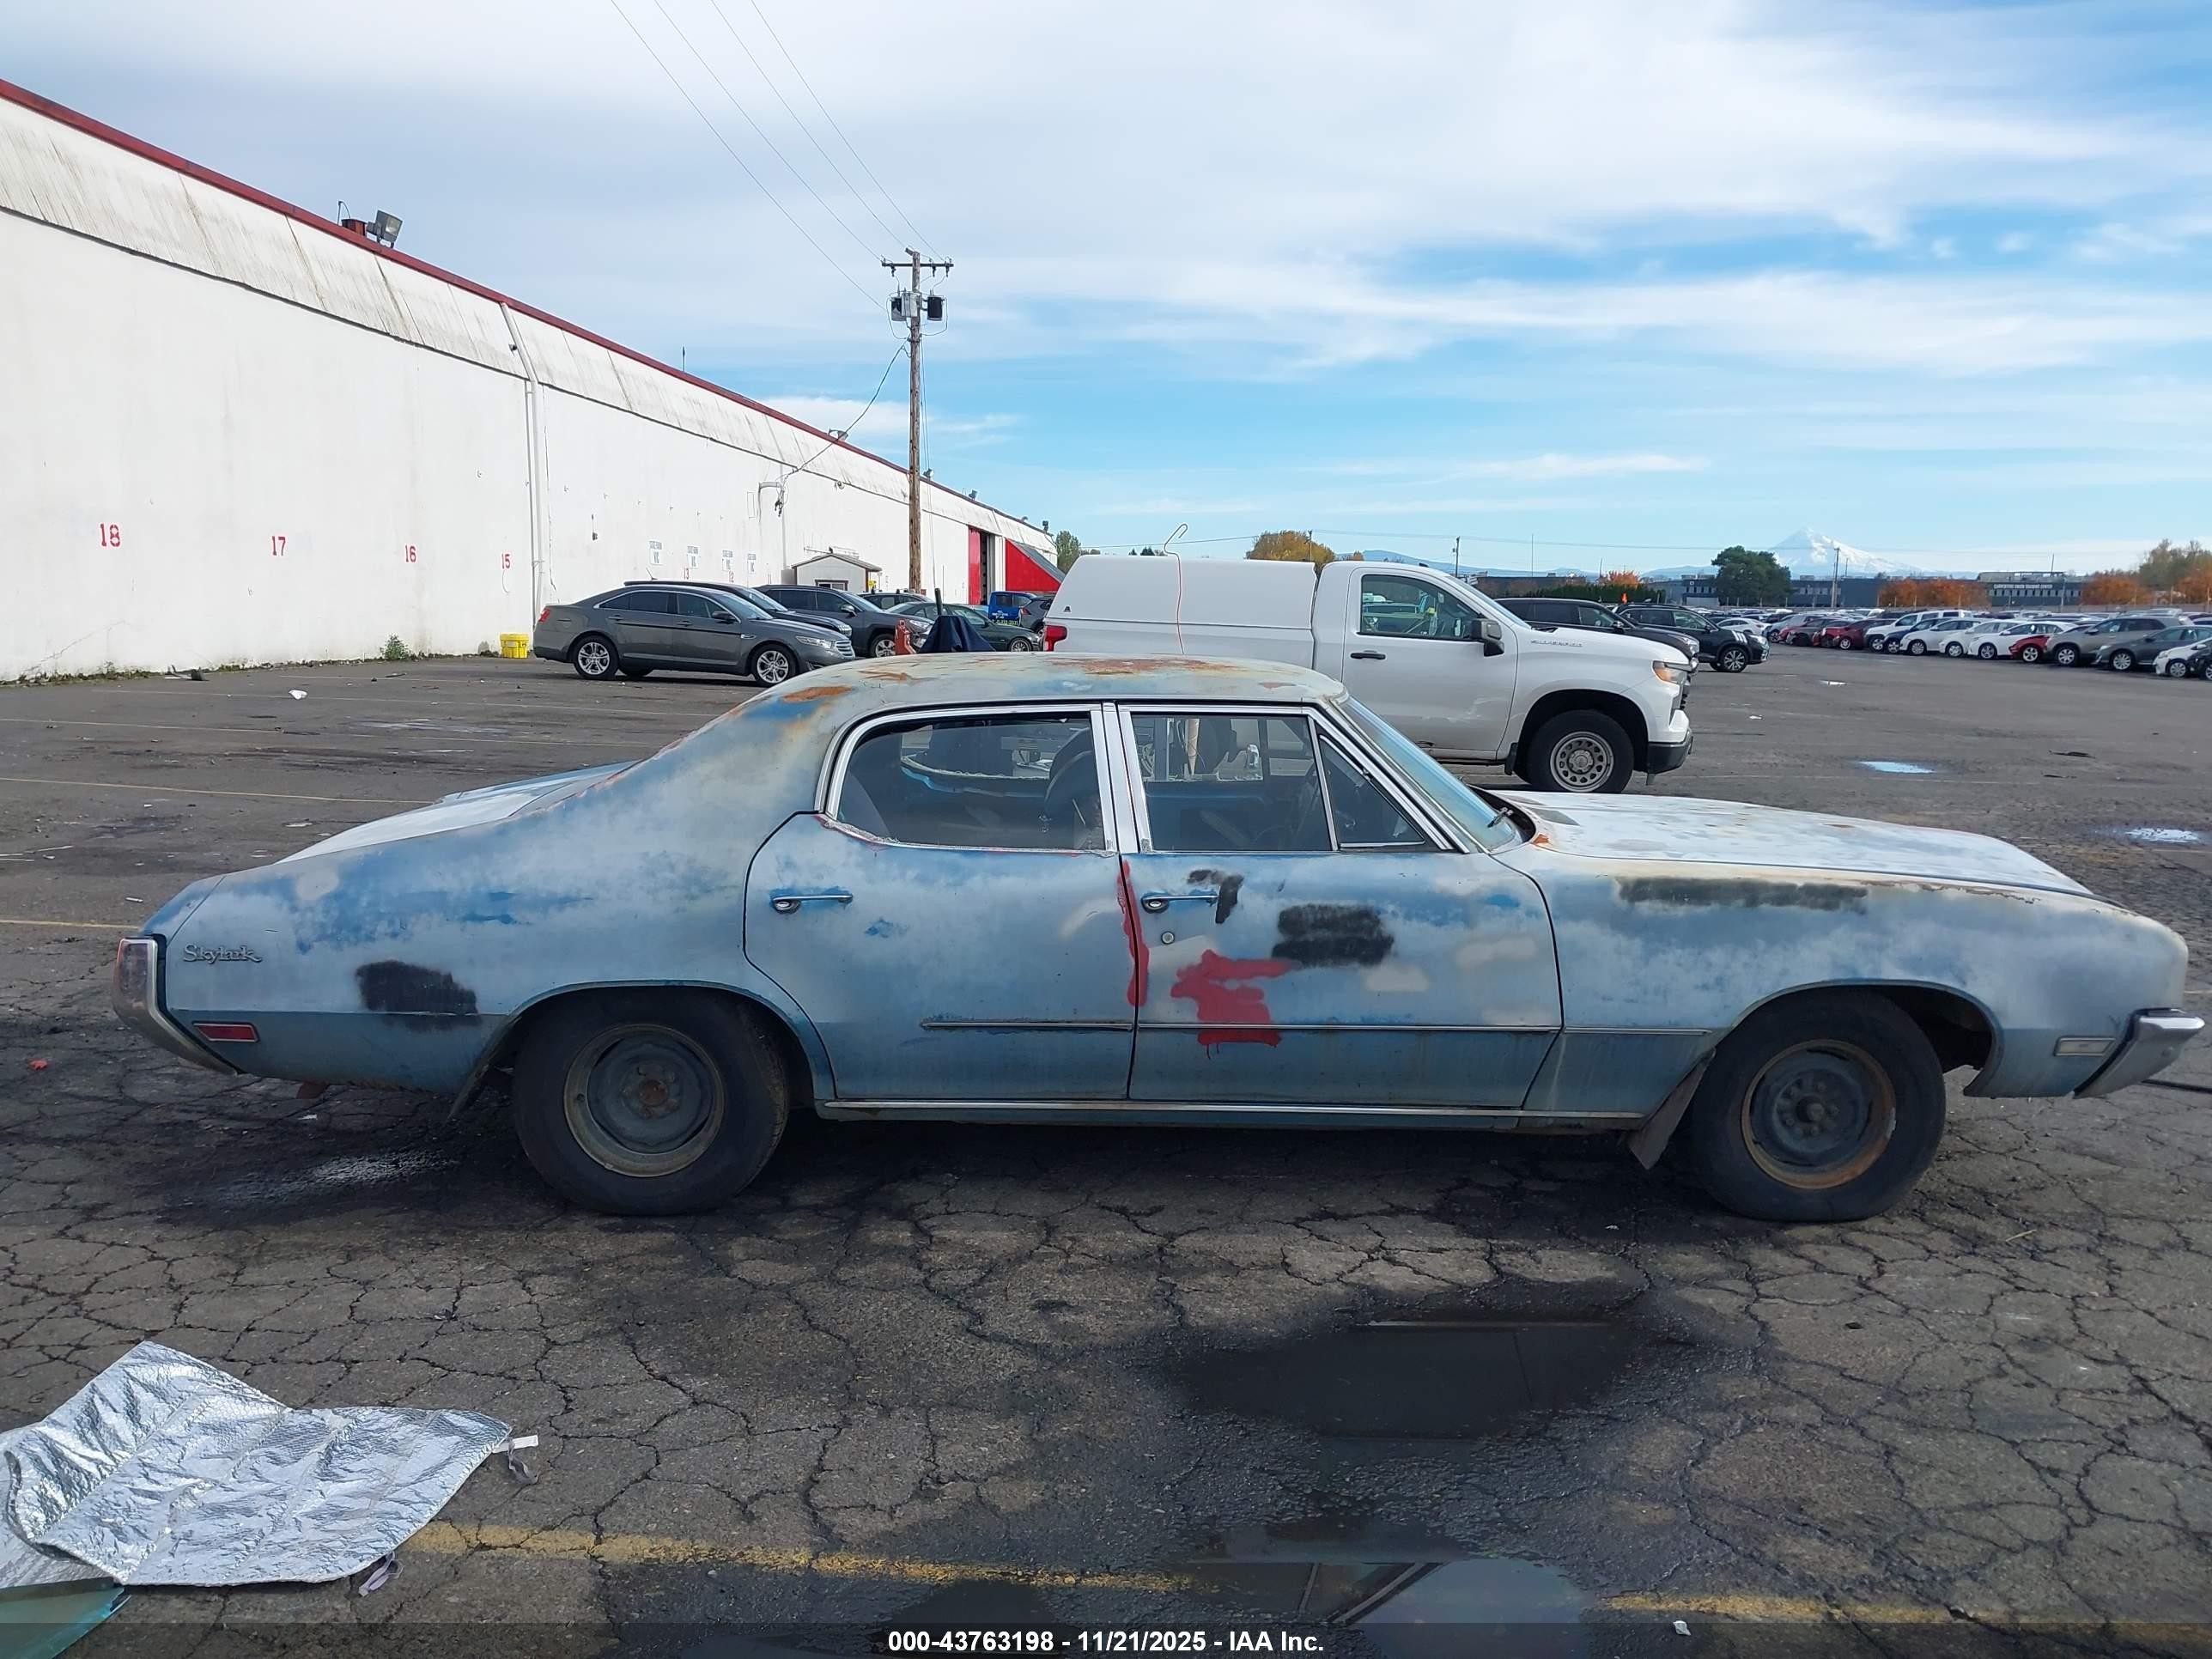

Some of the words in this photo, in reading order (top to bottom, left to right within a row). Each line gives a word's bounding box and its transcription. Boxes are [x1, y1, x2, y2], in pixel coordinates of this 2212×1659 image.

[99, 522, 122, 549] 18
[271, 536, 287, 556] 17
[404, 545, 416, 563] 16
[501, 554, 511, 569] 15
[183, 944, 262, 964] Skylark
